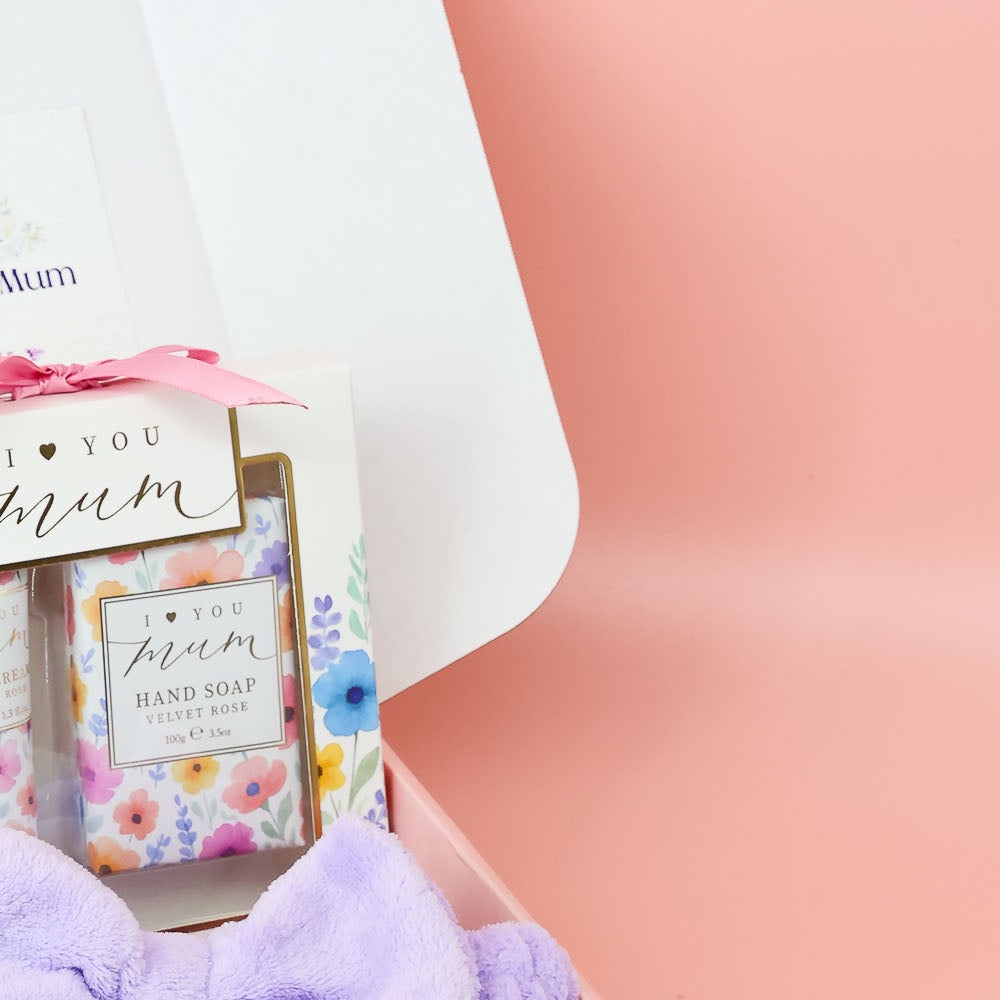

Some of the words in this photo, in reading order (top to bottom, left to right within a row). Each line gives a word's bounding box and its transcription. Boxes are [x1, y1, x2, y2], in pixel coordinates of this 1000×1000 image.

[0, 265, 77, 295] Mum
[5, 447, 16, 469] I
[81, 425, 161, 457] YOU
[144, 614, 150, 628] I
[193, 602, 243, 621] YOU
[107, 631, 278, 679] mum
[136, 686, 196, 709] HAND
[204, 677, 257, 700] SOAP
[146, 706, 204, 725] VELVET
[211, 700, 249, 716] ROSE
[165, 733, 187, 745] 100g
